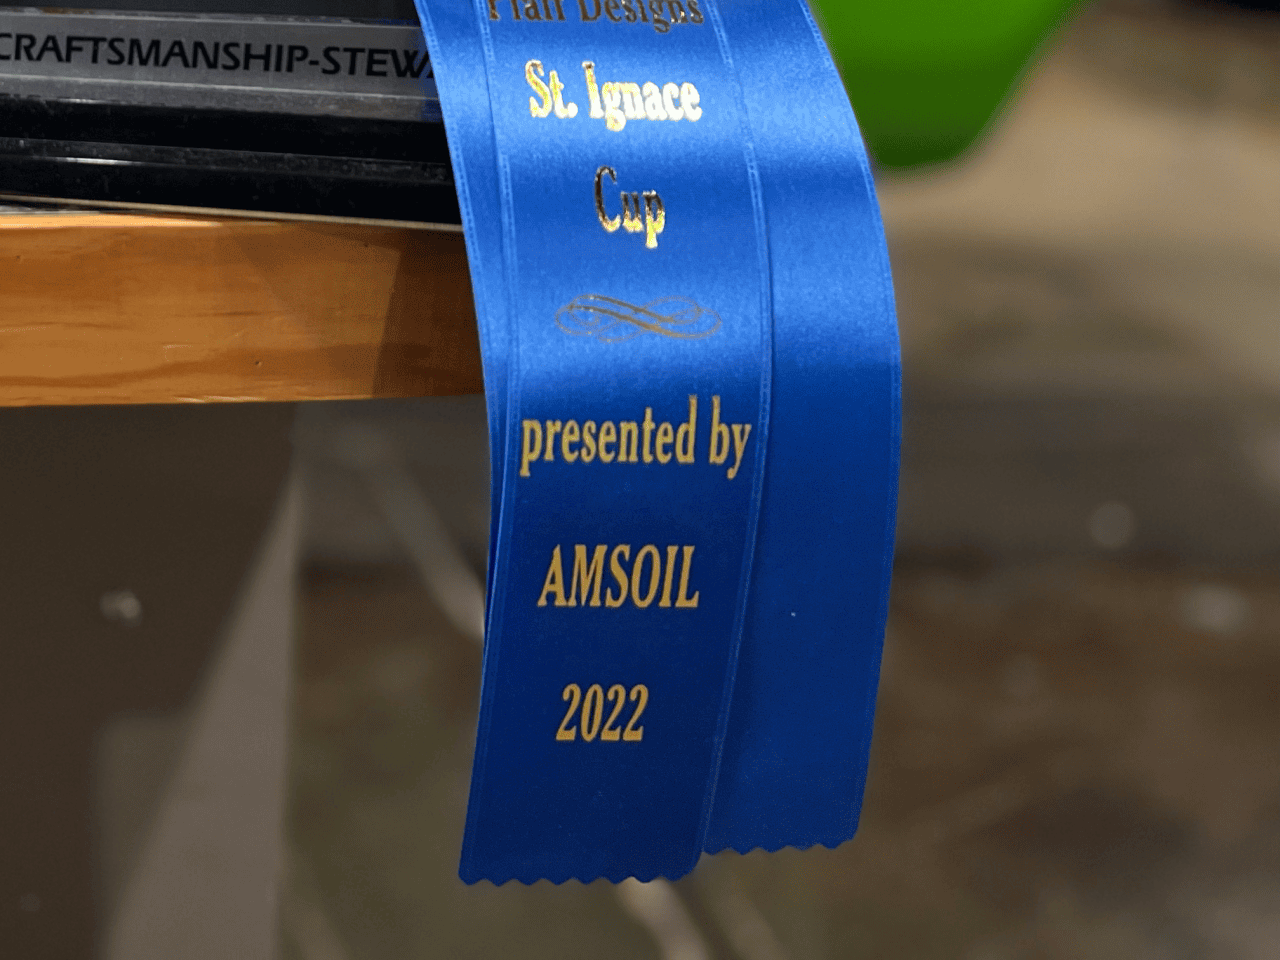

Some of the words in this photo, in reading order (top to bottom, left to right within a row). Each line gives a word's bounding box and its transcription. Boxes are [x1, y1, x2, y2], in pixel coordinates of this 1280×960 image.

[525, 58, 578, 119] St.
[582, 60, 703, 132] Ignace
[594, 165, 666, 249] Cup
[520, 393, 699, 478] presented
[709, 394, 752, 480] by
[537, 544, 700, 608] AMSOIL
[555, 683, 649, 742] 2022
